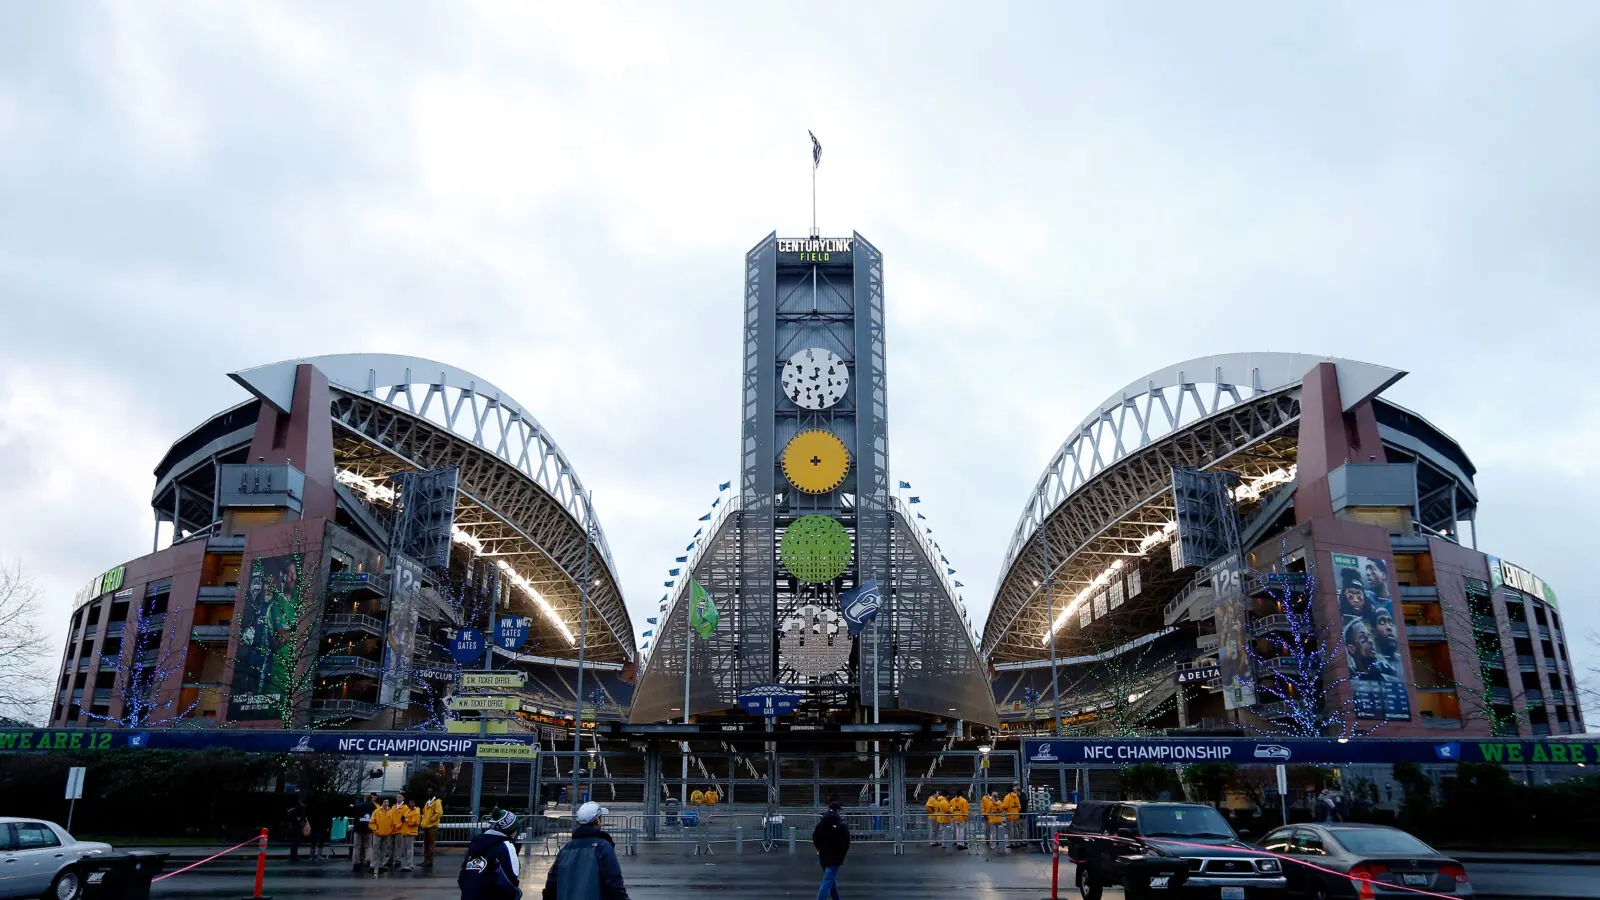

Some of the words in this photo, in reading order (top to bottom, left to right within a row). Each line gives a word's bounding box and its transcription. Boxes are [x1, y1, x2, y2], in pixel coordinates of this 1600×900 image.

[778, 239, 850, 252] CENTURYLINK
[800, 252, 830, 262] FIELD
[463, 631, 473, 640] NE
[501, 629, 521, 637] GATES
[457, 641, 477, 650] GATES
[505, 638, 516, 647] SW
[1187, 668, 1221, 680] DELTA
[494, 677, 511, 685] OFFICE
[470, 700, 486, 708] TICKET
[487, 700, 504, 708] OFFICE
[765, 697, 773, 708] N
[0, 732, 34, 750] WE
[36, 732, 84, 750] ARE
[87, 732, 113, 750] 12
[338, 738, 365, 751] NFC
[367, 739, 472, 752] CHAMPIONSHIP
[1084, 746, 1113, 759] NFC
[1117, 746, 1232, 759] CHAMPIONSHIP
[1478, 743, 1524, 762] WE
[1531, 743, 1587, 762] ARE
